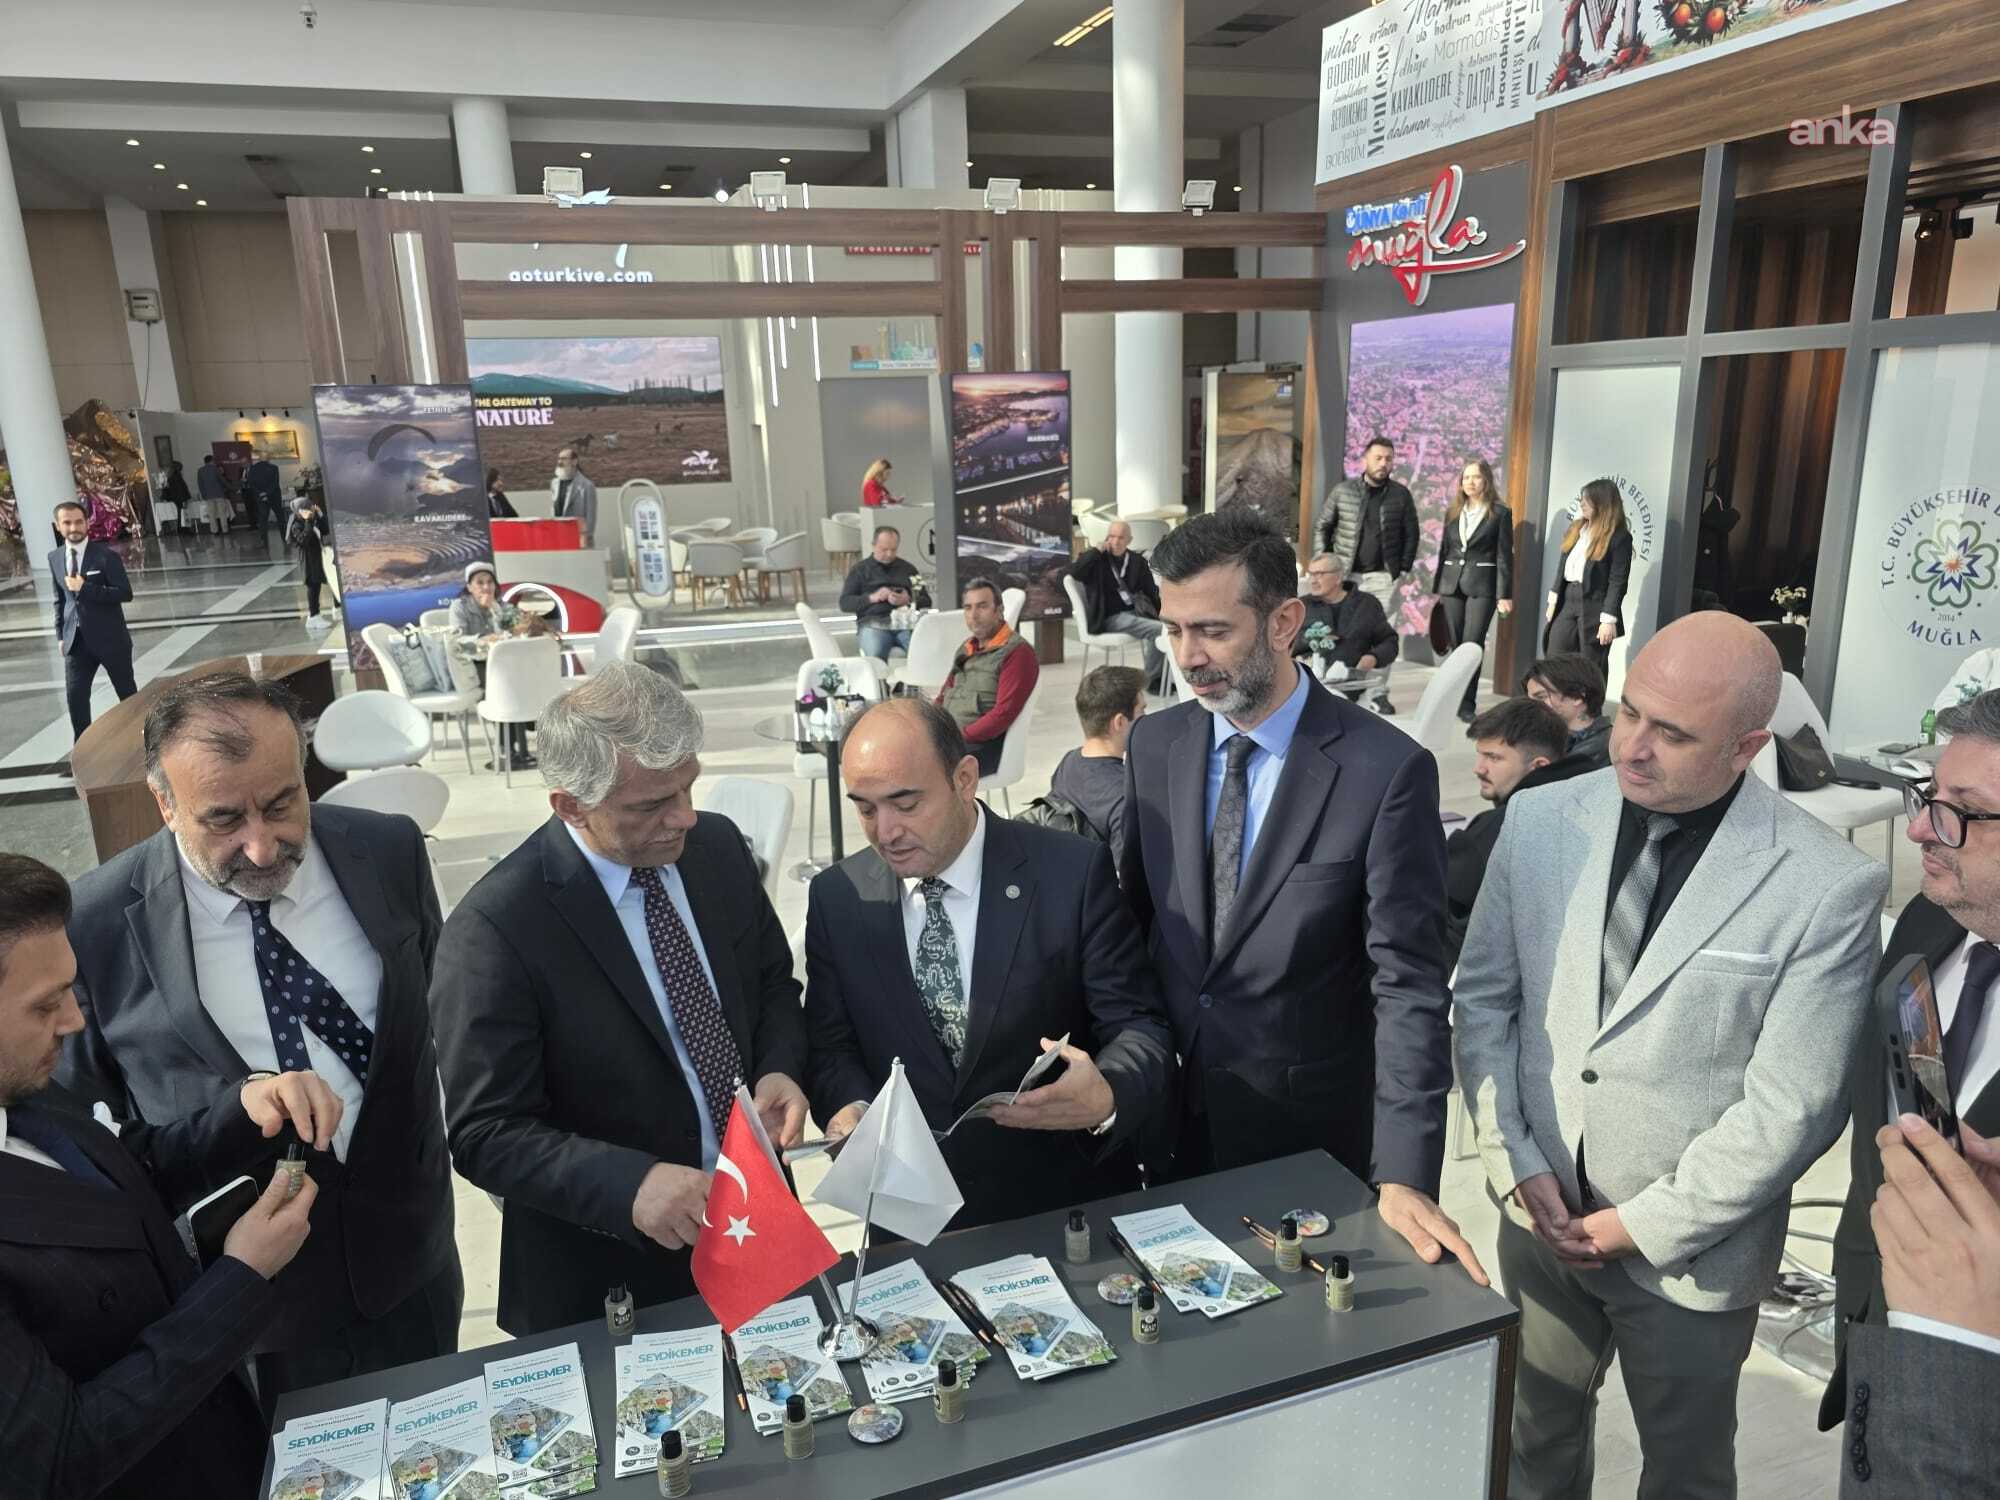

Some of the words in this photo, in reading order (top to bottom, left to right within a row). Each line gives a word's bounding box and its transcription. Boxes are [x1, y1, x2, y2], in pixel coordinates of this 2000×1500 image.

[1323, 27, 1359, 64] milas
[1434, 23, 1500, 63] Marmaris
[1326, 51, 1370, 90] BODRUM
[1391, 70, 1453, 116] KAVAKLIDERE
[1466, 65, 1496, 113] DATÇA
[1386, 116, 1431, 141] dalaman
[1325, 143, 1366, 170] BODRUM
[492, 396, 536, 408] GATEWAY
[537, 395, 552, 407] TO
[475, 408, 554, 427] NATURE
[1887, 487, 1991, 549] BÜYÜKŞEHİR
[1881, 555, 1896, 590] T.C.
[1906, 619, 1982, 646] MUĞLA
[982, 1274, 1042, 1296] SEYDİKEMER
[738, 1316, 811, 1338] SEYDİKEMER
[638, 1343, 714, 1364] SEYDİKEMER
[491, 1363, 572, 1390] SEYDİKEMER
[394, 1399, 479, 1435] SEYDİKEMER
[287, 1422, 375, 1450] SEYDİKEMER
